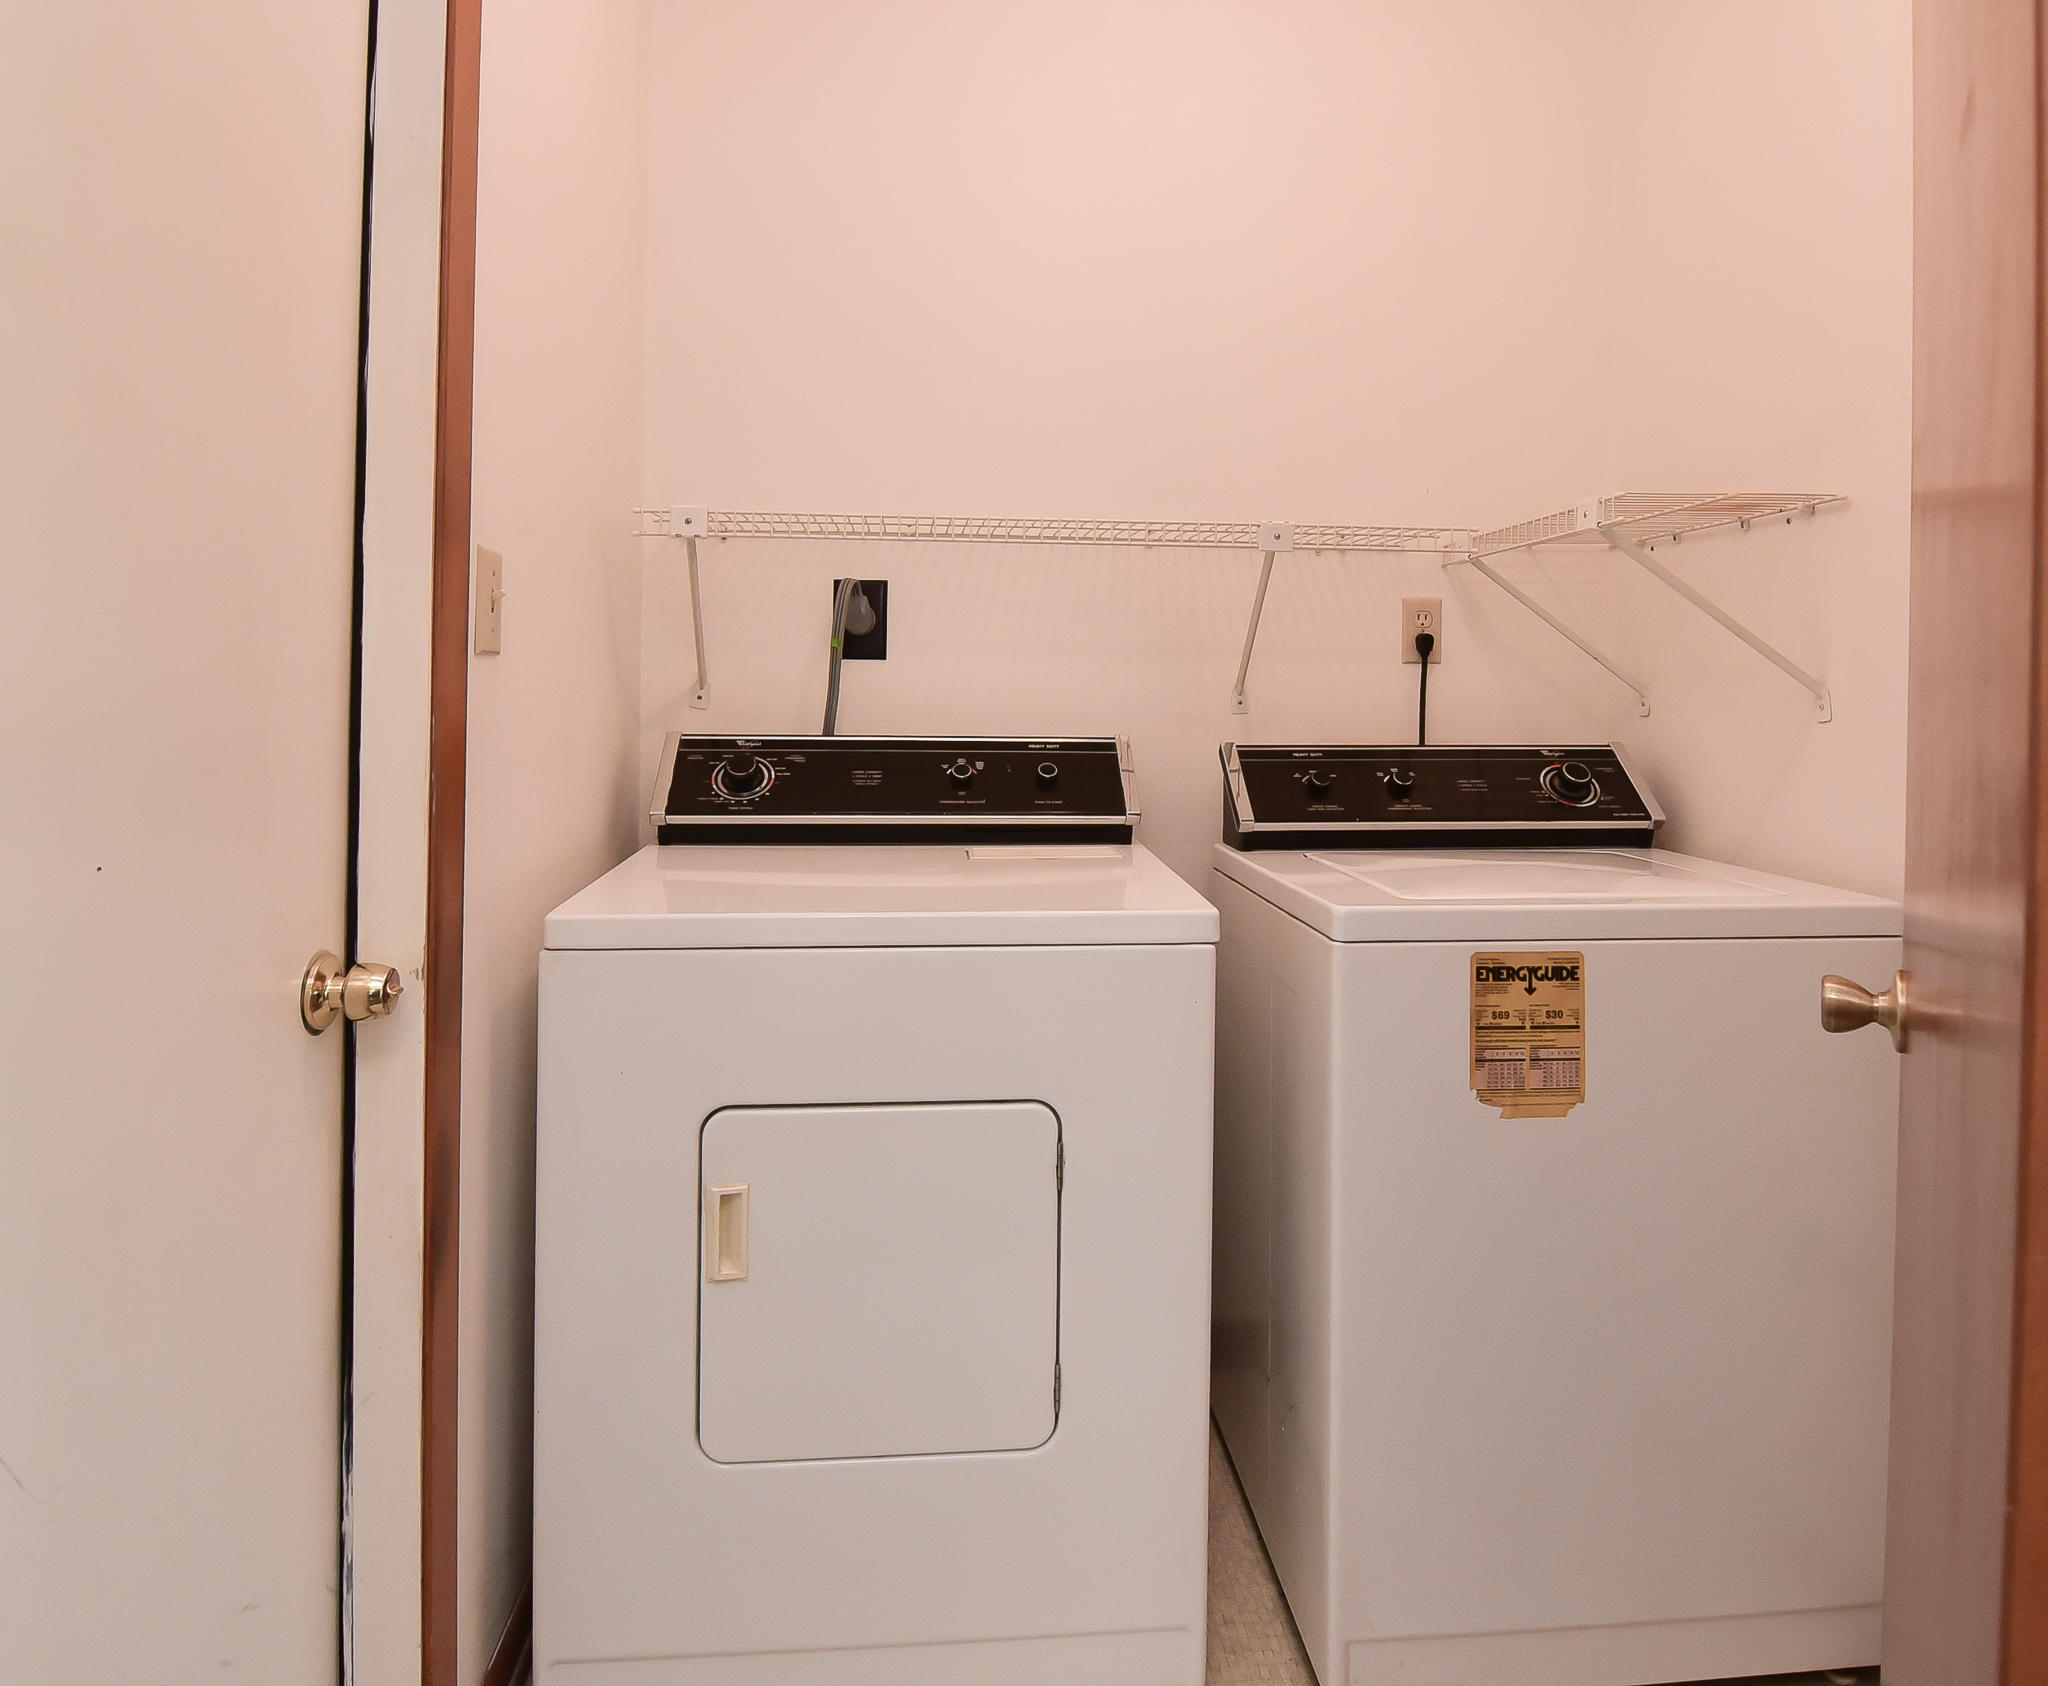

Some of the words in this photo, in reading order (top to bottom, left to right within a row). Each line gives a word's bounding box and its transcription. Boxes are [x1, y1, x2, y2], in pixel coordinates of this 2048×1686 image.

[1475, 965, 1580, 982] ENERGYGUIDE
[1491, 1010, 1511, 1020] $69
[1545, 1009, 1564, 1019] $30
